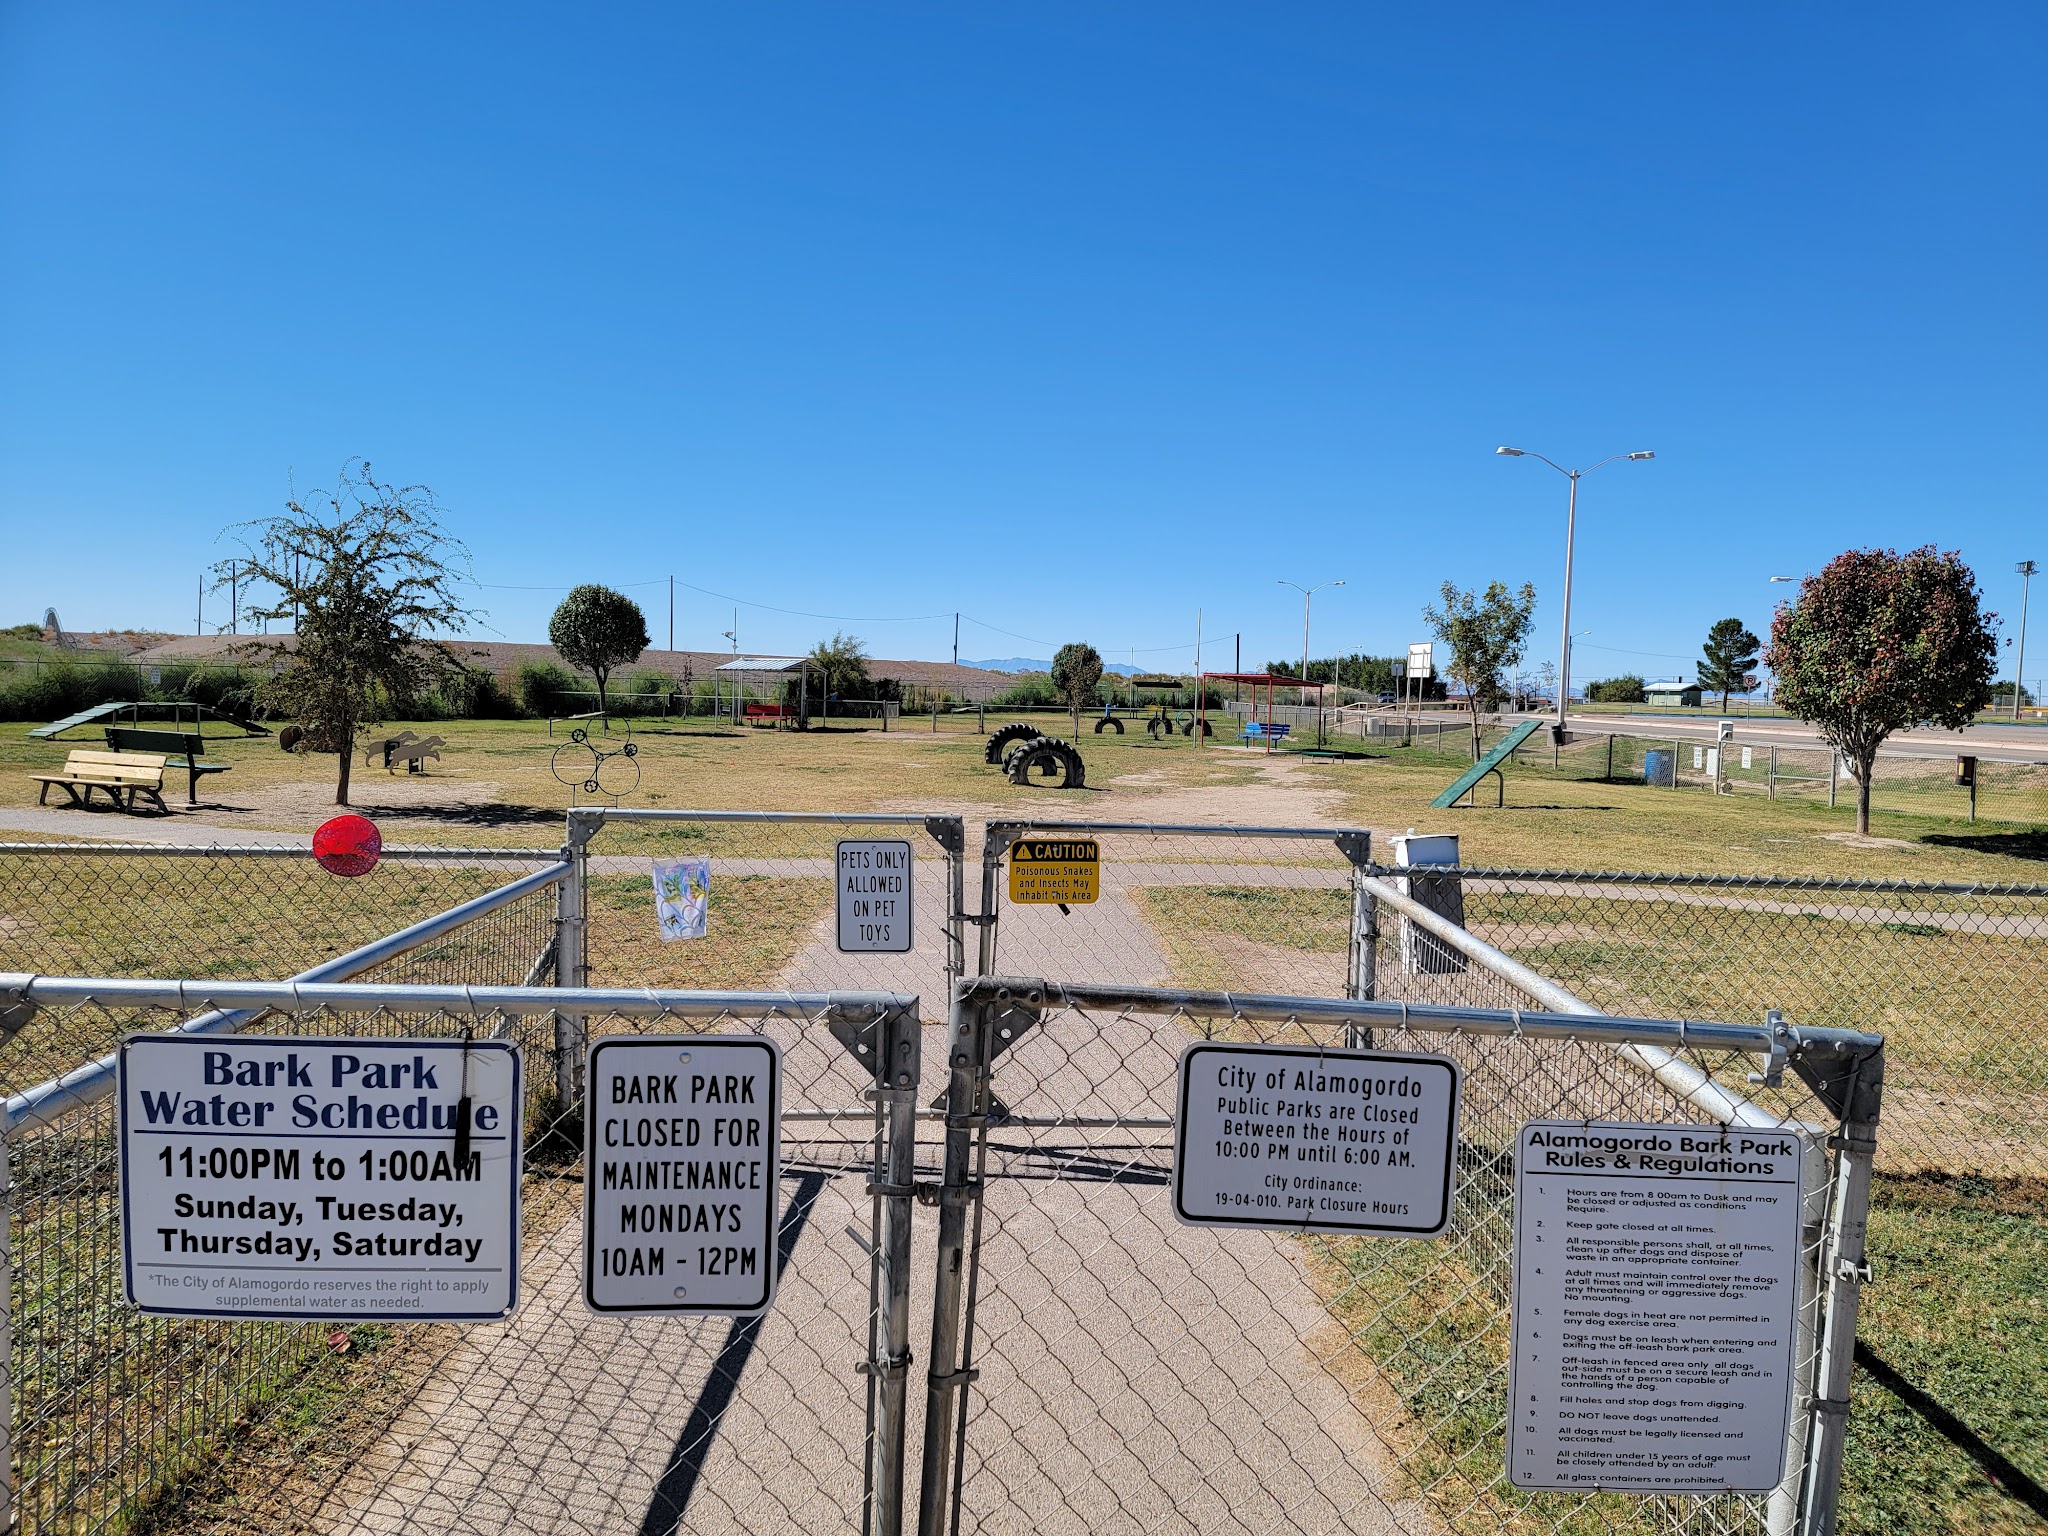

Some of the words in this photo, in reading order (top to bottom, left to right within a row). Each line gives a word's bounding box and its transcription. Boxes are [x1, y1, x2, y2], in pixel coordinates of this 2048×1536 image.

[1035, 844, 1094, 859] CAUTION
[842, 852, 869, 868] PETS
[877, 852, 906, 868] ONLY
[1016, 866, 1059, 875] Poisonous
[1064, 866, 1092, 875] Snakes
[847, 876, 901, 892] ALLOWED
[1020, 879, 1035, 887] and
[1040, 879, 1069, 887] Insects
[1073, 879, 1089, 890] May
[1017, 891, 1048, 900] Inhabit
[1072, 891, 1091, 899] Area
[854, 901, 868, 917] ON
[876, 901, 895, 916] PET
[860, 925, 890, 941] TOYS
[204, 1052, 312, 1087] Bark
[332, 1054, 438, 1090] Park
[612, 1076, 678, 1104] BARK
[692, 1076, 755, 1104] PARK
[1218, 1065, 1256, 1093] City
[1266, 1069, 1285, 1089] of
[1294, 1070, 1421, 1100] Alamogordo
[140, 1090, 274, 1127] Water
[292, 1094, 498, 1130] Schedue
[1218, 1097, 1269, 1115] Public
[1277, 1100, 1321, 1119] Parks
[1330, 1106, 1355, 1120] are
[1364, 1105, 1418, 1124] Closed
[605, 1119, 699, 1147] CLOSED
[714, 1119, 760, 1147] FOR
[1224, 1120, 1295, 1138] Between
[1304, 1123, 1329, 1140] the
[1338, 1126, 1385, 1144] Hours
[1394, 1129, 1409, 1145] of
[1529, 1131, 1672, 1154] Alamogordo
[1681, 1138, 1732, 1154] Bark
[1741, 1140, 1793, 1157] Park
[1216, 1141, 1259, 1158] 10:00
[1268, 1144, 1289, 1160] PM
[1298, 1145, 1336, 1163] until
[1344, 1148, 1379, 1165] 6:00
[1388, 1151, 1415, 1167] AM.
[159, 1146, 299, 1180] 11:00PM
[313, 1150, 345, 1181] to
[359, 1150, 481, 1182] 1:00AM
[1546, 1152, 1606, 1168] Rules
[1614, 1154, 1631, 1170] &
[1640, 1154, 1774, 1175] Regulations
[603, 1162, 760, 1190] MAINTENANCE
[1265, 1175, 1287, 1191] City
[1294, 1177, 1362, 1193] Ordinance:
[175, 1194, 302, 1226] Sunday,
[316, 1197, 463, 1228] Tuesday,
[1216, 1193, 1281, 1208] 19-04-010.
[1288, 1196, 1314, 1209] Park
[1321, 1198, 1366, 1212] Closure
[1373, 1201, 1409, 1215] Hours
[621, 1204, 741, 1233] MONDAYS
[1566, 1222, 1593, 1230] Keep
[158, 1229, 320, 1261] Thursday,
[333, 1232, 482, 1262] Saturday
[1686, 1242, 1712, 1250] shall,
[1744, 1244, 1774, 1252] times,
[602, 1248, 664, 1276] 10AM
[698, 1247, 756, 1276] 12PM
[1628, 1257, 1688, 1265] appropriate
[184, 1276, 208, 1290] City
[212, 1277, 225, 1288] of
[229, 1277, 309, 1292] Alamogordo
[314, 1280, 371, 1291] reserves
[376, 1279, 397, 1291] the
[401, 1279, 432, 1293] right
[436, 1280, 449, 1291] to
[453, 1279, 489, 1293] apply
[1754, 1276, 1778, 1284] dogs
[216, 1294, 305, 1308] supplemental
[310, 1296, 347, 1307] water
[351, 1298, 366, 1307] as
[370, 1296, 424, 1308] needed.
[1582, 1295, 1633, 1304] mounting.
[1604, 1311, 1628, 1319] dogs
[1563, 1342, 1596, 1350] exiting
[1628, 1398, 1649, 1407] stop
[1652, 1399, 1677, 1407] dogs
[1707, 1400, 1746, 1409] digging.
[1633, 1414, 1658, 1422] dogs
[1574, 1428, 1599, 1436] dogs
[1645, 1429, 1678, 1438] legally
[1572, 1474, 1596, 1482] glass
[1600, 1474, 1651, 1483] containers
[1674, 1476, 1726, 1485] prohibited.
